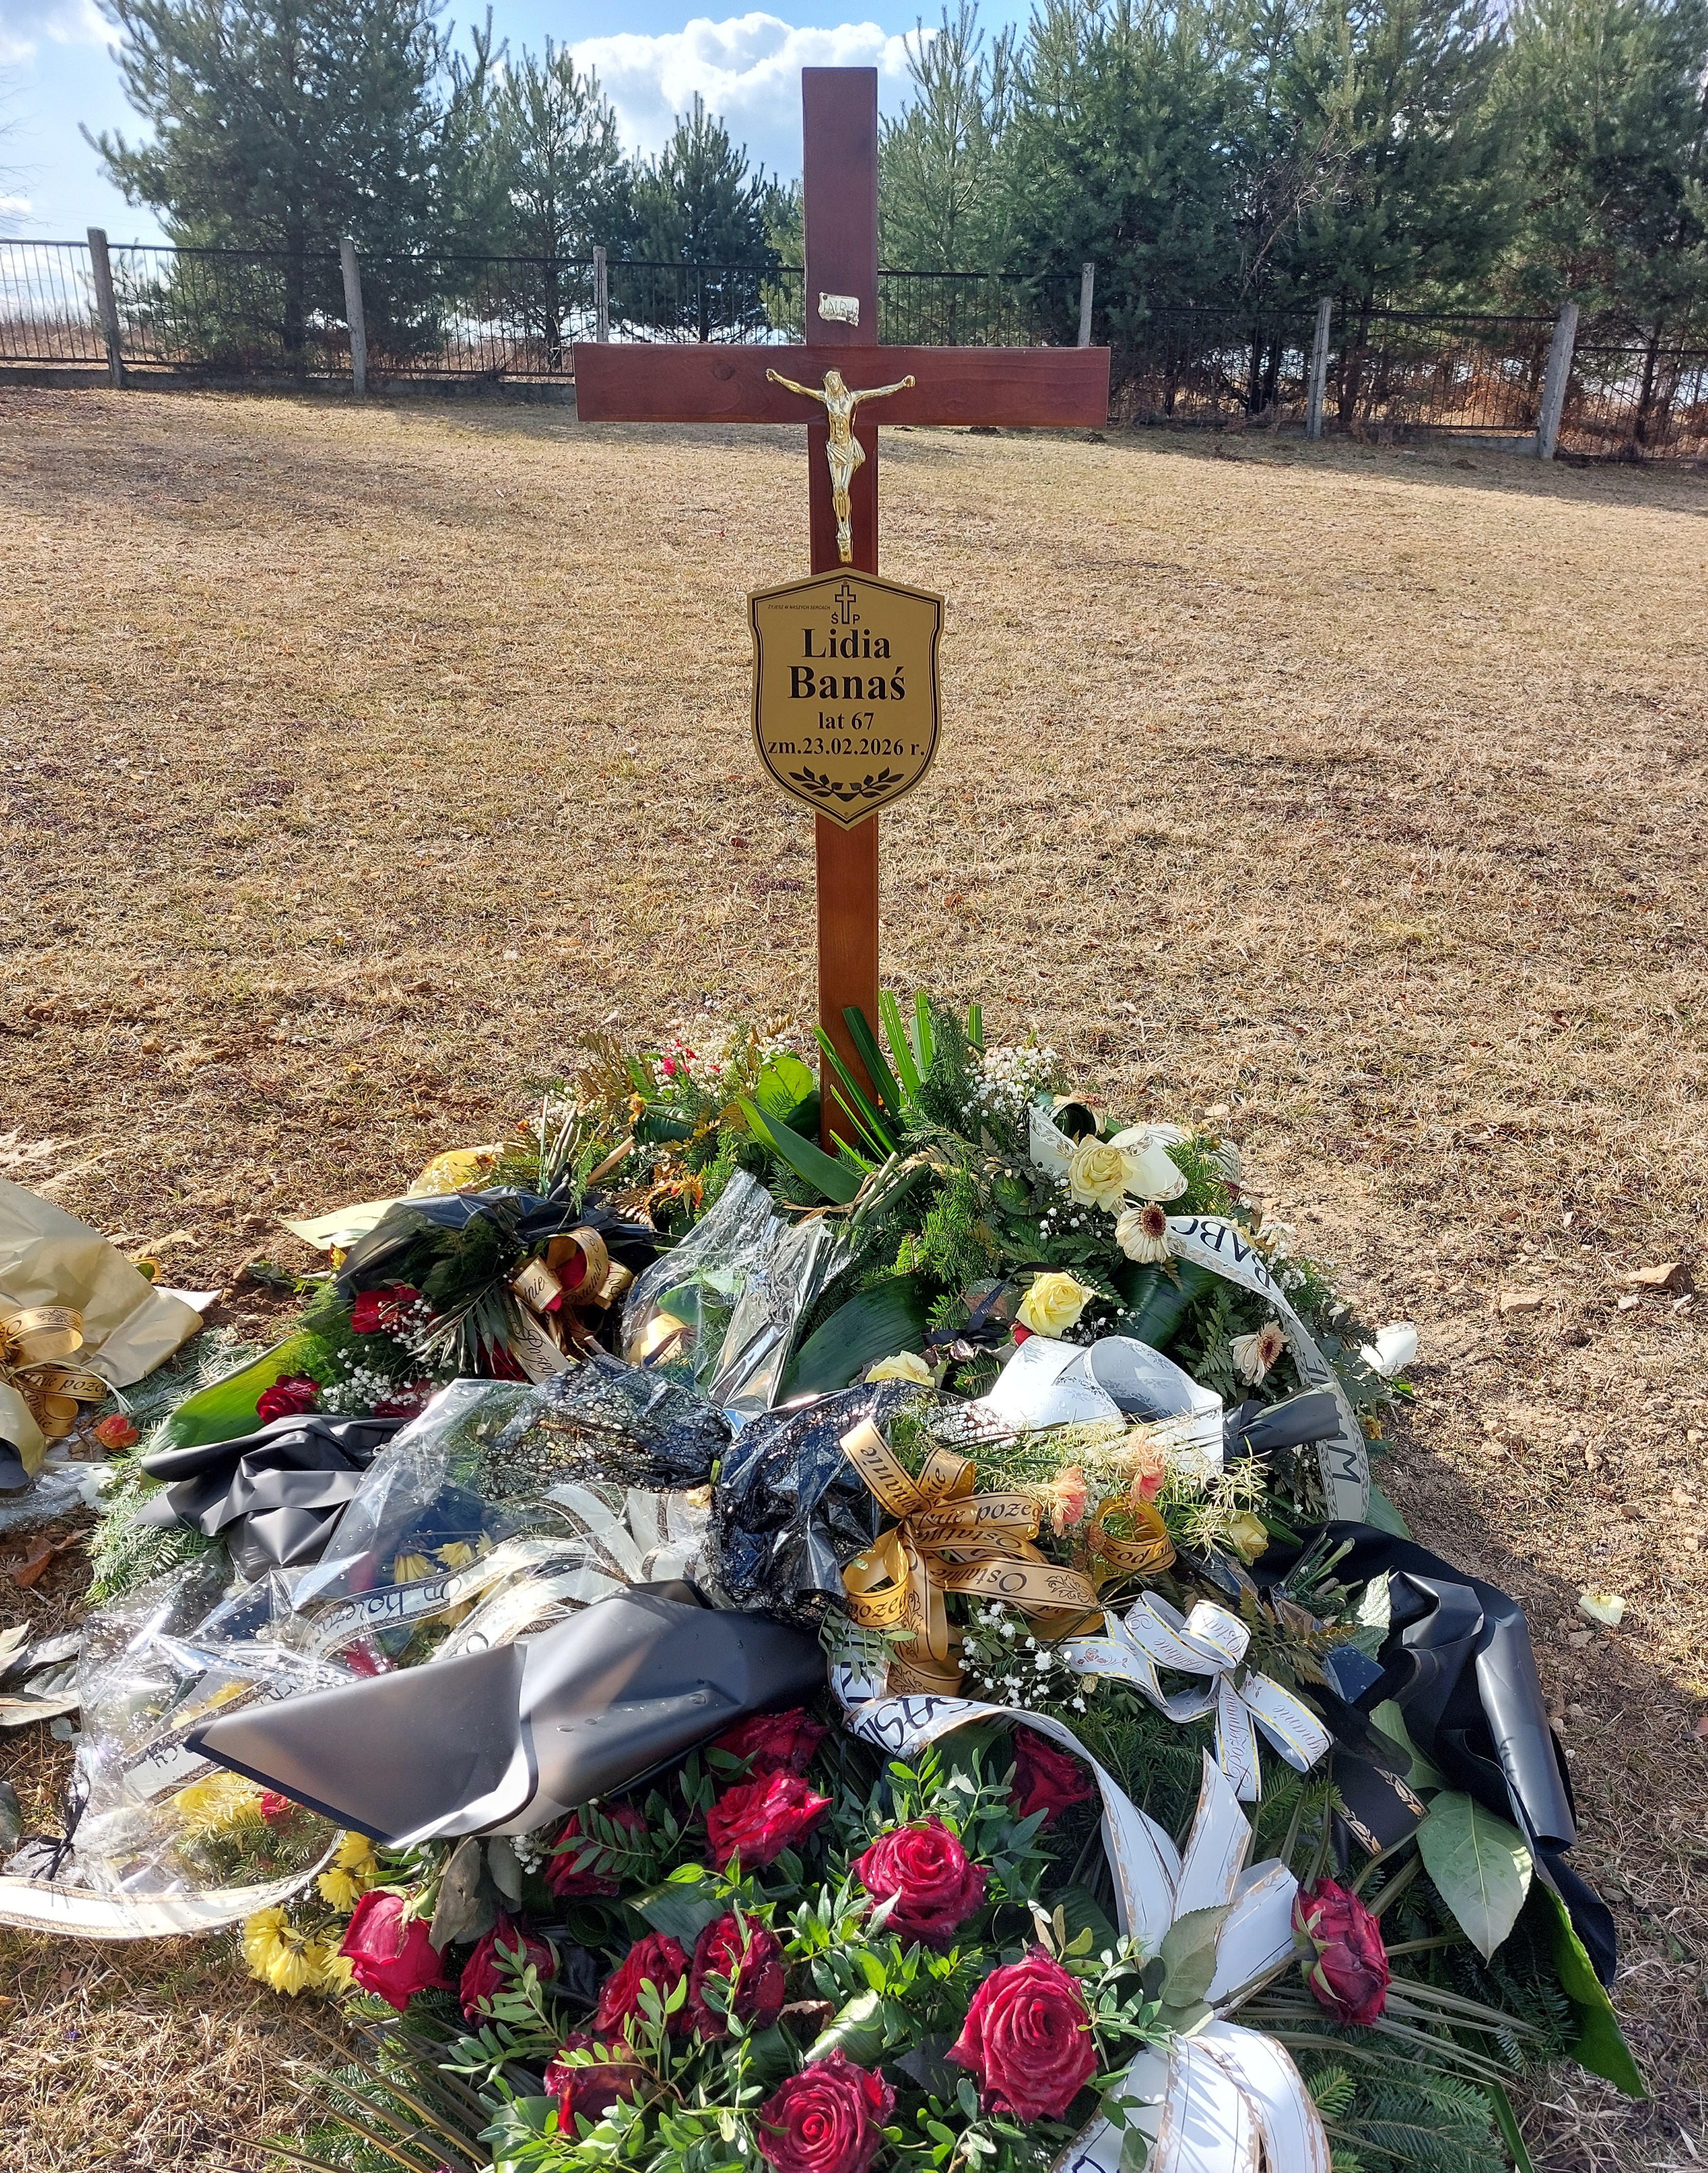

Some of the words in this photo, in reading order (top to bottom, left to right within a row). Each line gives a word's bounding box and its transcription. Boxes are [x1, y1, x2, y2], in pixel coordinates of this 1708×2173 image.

[823, 300, 854, 315] INRI
[831, 612, 839, 624] Ś
[853, 614, 860, 624] P
[801, 628, 892, 659] Lidia
[787, 665, 906, 701] Banaś
[818, 711, 844, 729] lat
[851, 711, 875, 730] 67
[767, 738, 904, 756] zm.23.02.2026
[910, 741, 925, 756] r.
[1153, 1638, 1206, 1670] Ostatnie
